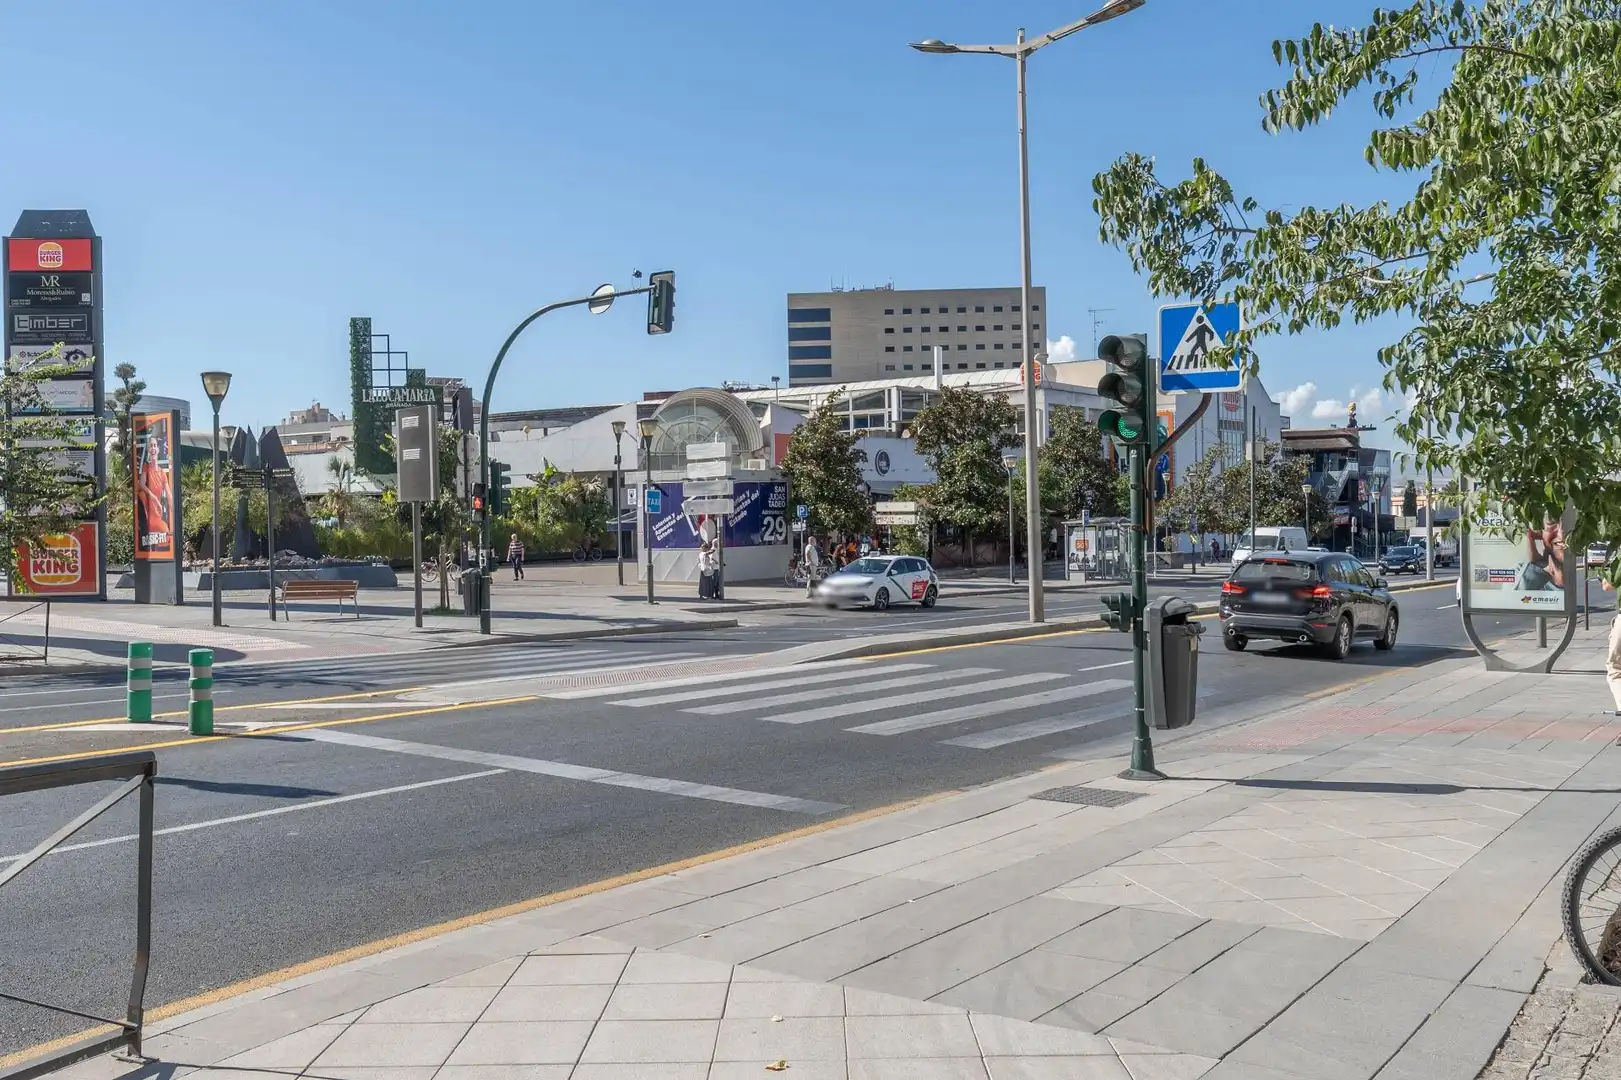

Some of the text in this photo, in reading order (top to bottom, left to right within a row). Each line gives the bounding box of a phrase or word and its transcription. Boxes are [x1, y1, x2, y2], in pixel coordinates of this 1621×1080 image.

[40, 275, 60, 287] MR
[728, 510, 747, 527] Estado
[655, 519, 676, 536] Apuestas
[657, 528, 673, 541] Estado
[763, 516, 786, 541] 29
[33, 560, 78, 574] KING
